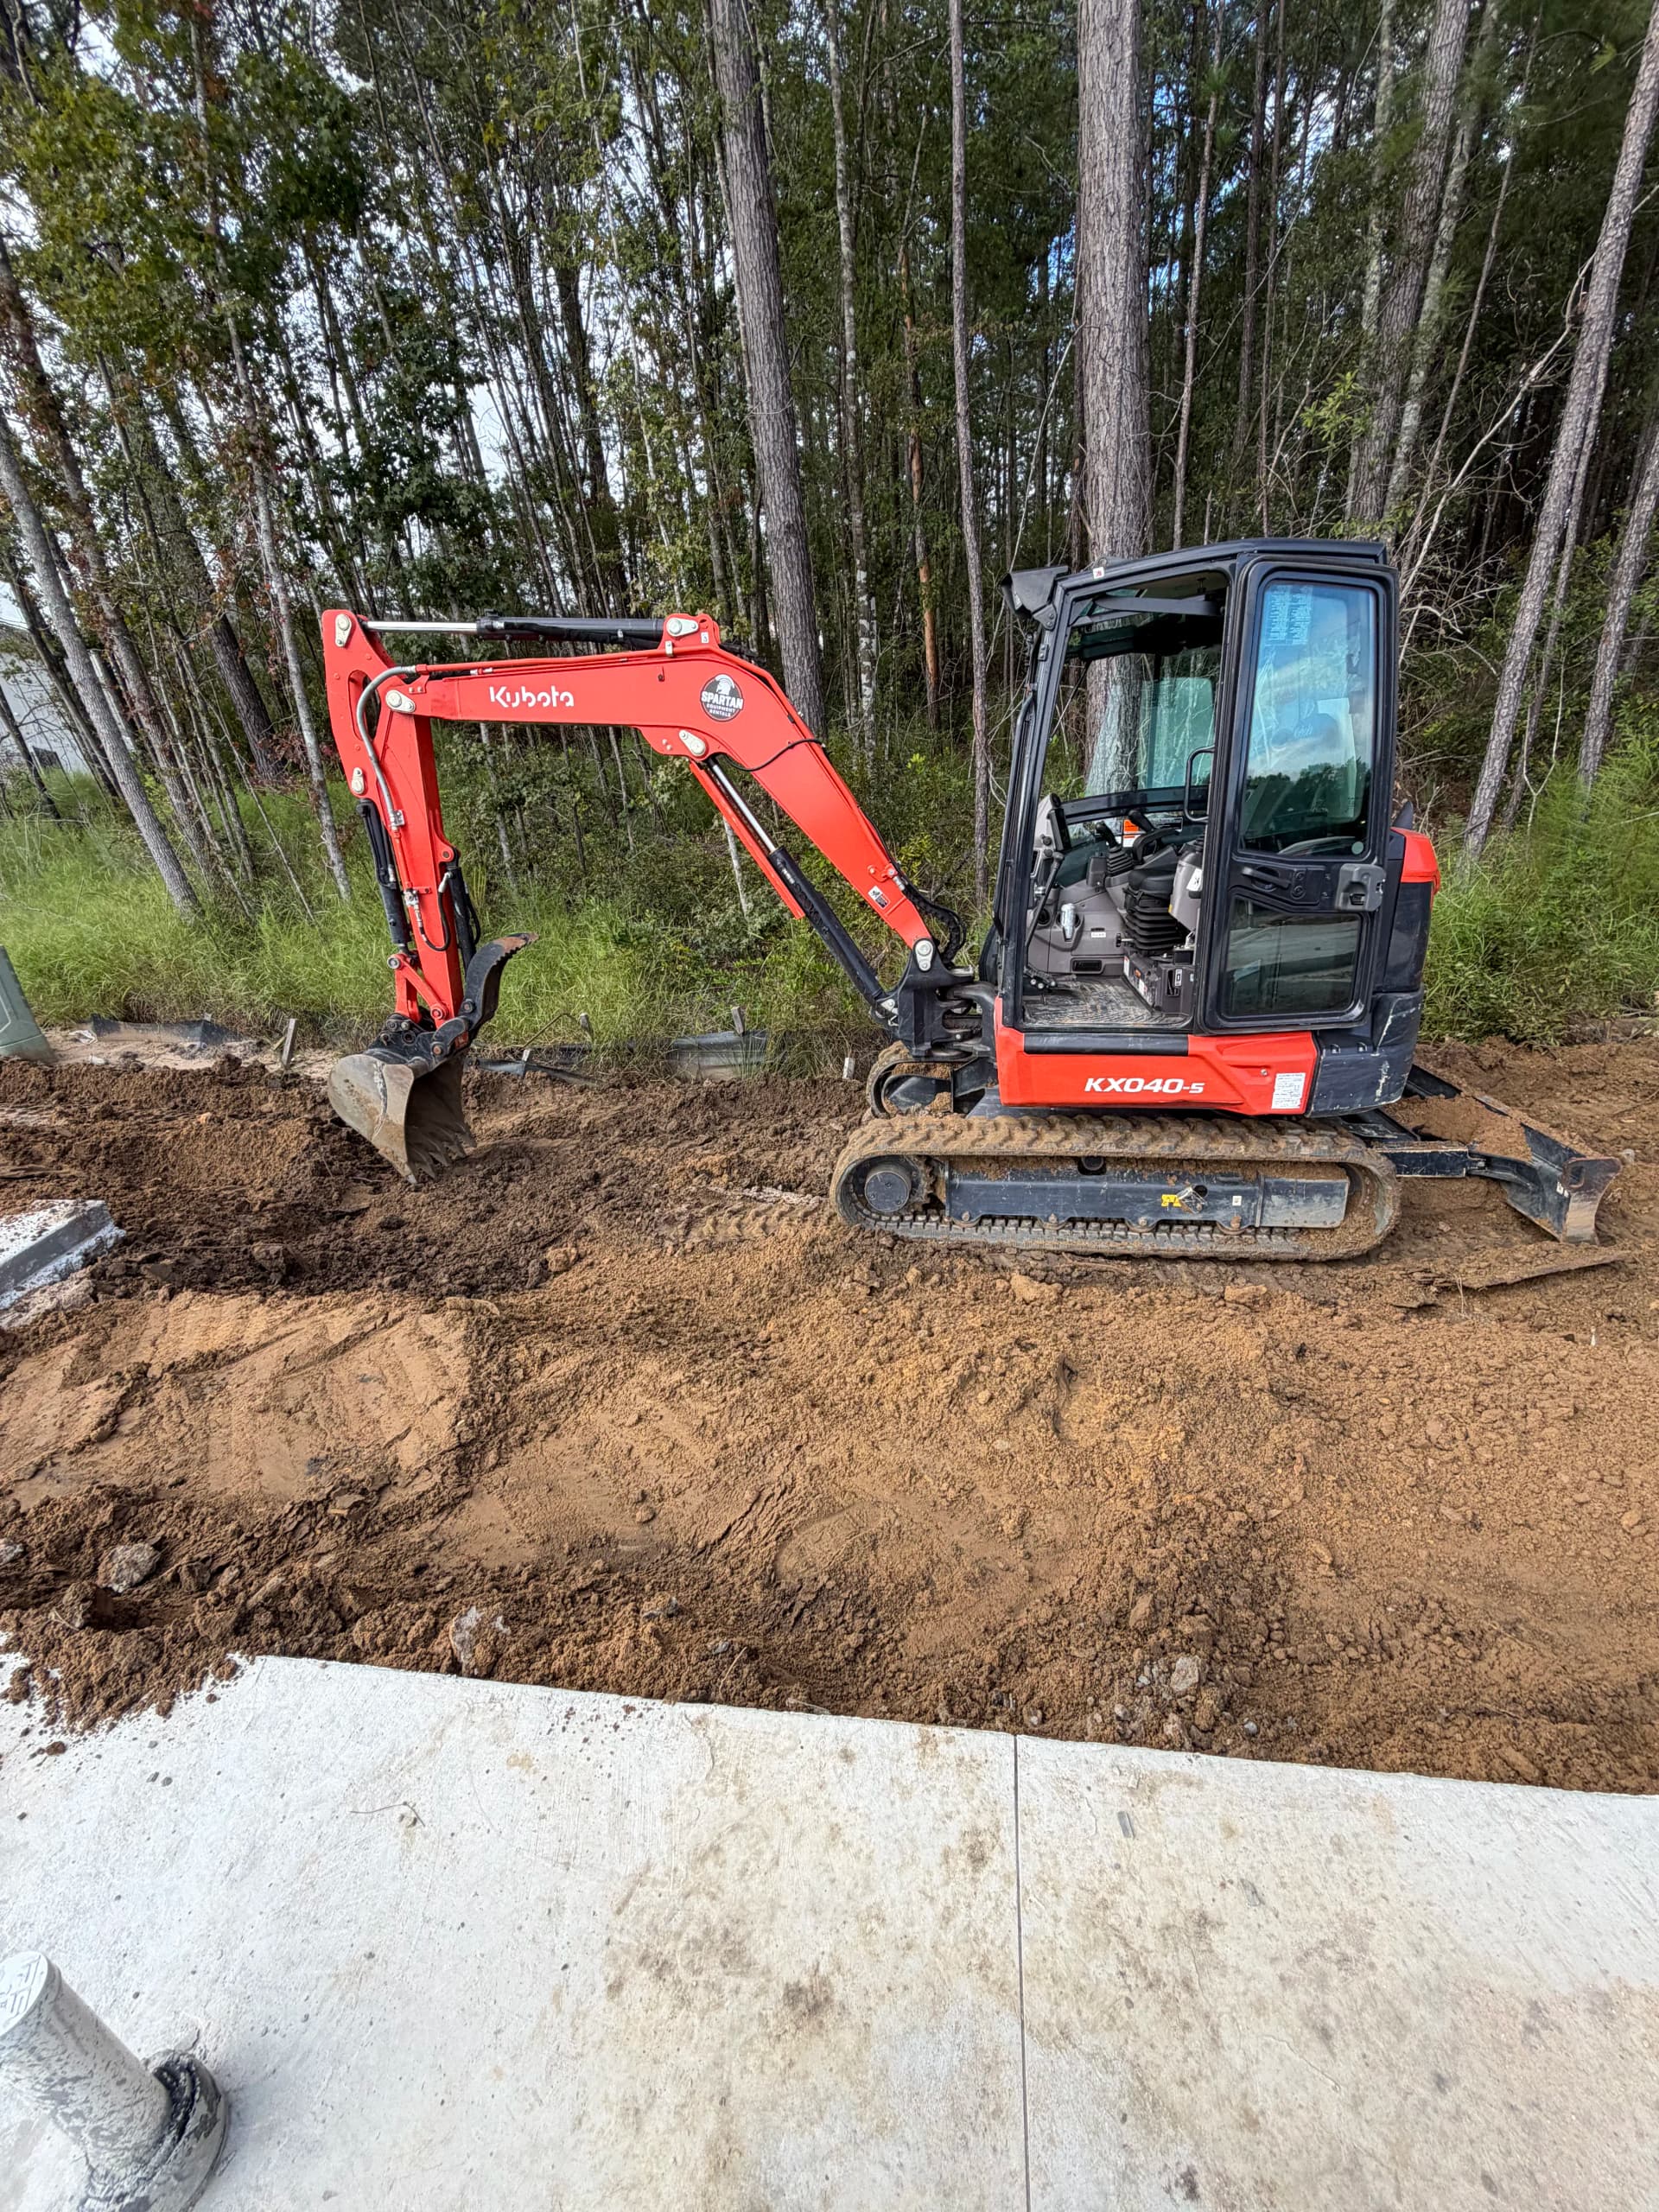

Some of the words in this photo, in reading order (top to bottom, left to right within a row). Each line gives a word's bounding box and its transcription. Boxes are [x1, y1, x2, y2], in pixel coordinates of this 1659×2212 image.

[489, 685, 575, 708] Kubota
[701, 691, 743, 709] SPARTAN
[706, 703, 736, 713] EQUIPMENT
